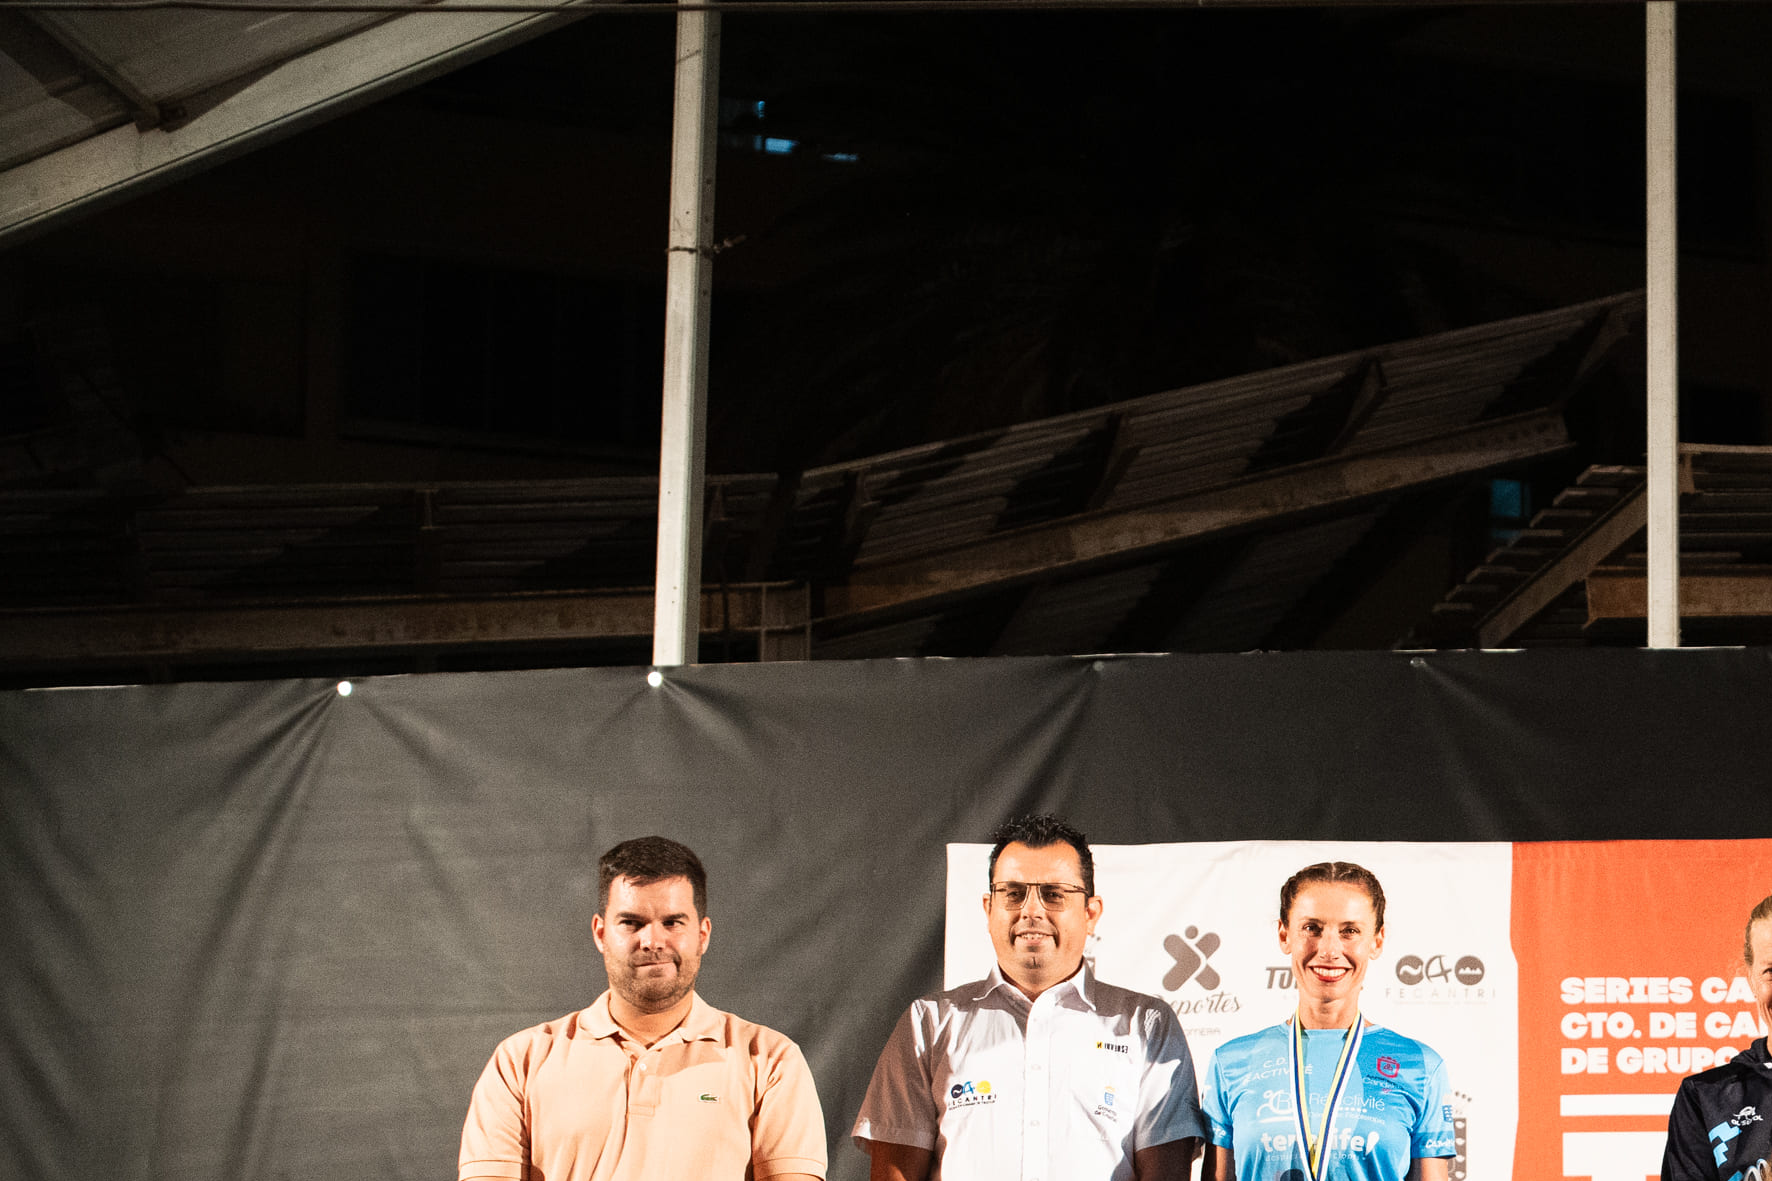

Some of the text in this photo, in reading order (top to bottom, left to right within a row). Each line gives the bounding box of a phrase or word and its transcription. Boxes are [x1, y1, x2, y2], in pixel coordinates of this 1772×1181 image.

[1560, 976, 1693, 1005] SERIES
[1560, 1011, 1642, 1040] CTO.
[1649, 1011, 1697, 1039] DE
[1561, 1047, 1609, 1074] DE
